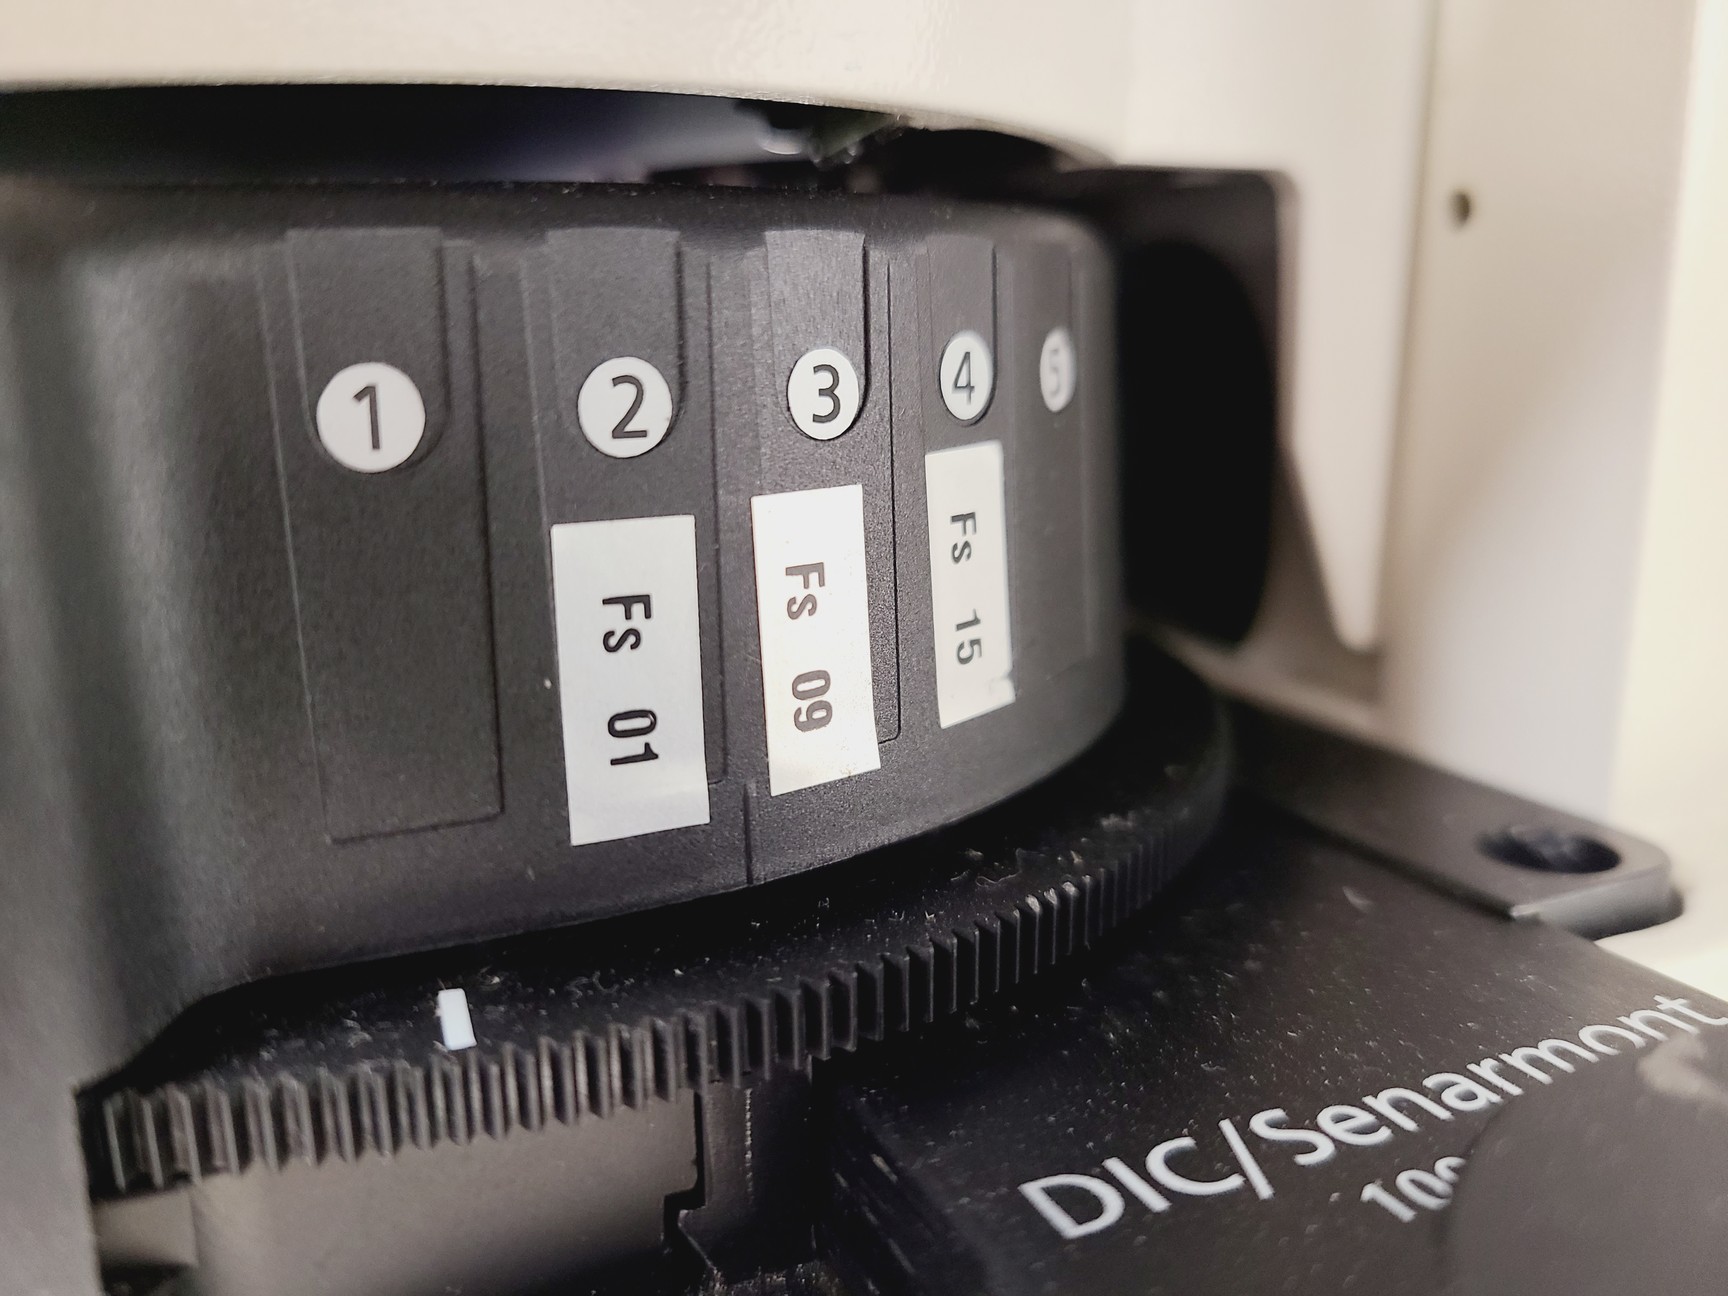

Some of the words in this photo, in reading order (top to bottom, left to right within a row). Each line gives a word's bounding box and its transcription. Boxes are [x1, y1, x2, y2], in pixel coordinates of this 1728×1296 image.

[611, 374, 648, 440] 2
[813, 363, 841, 424] 3
[952, 351, 977, 404] 4
[352, 384, 381, 451] 1
[950, 511, 977, 564] Fs
[785, 561, 826, 621] Fs
[602, 593, 652, 654] Fs
[955, 610, 983, 666] 15
[791, 669, 833, 733] 09
[607, 709, 659, 766] 01
[1018, 994, 1728, 1240] DIC/Senarmont
